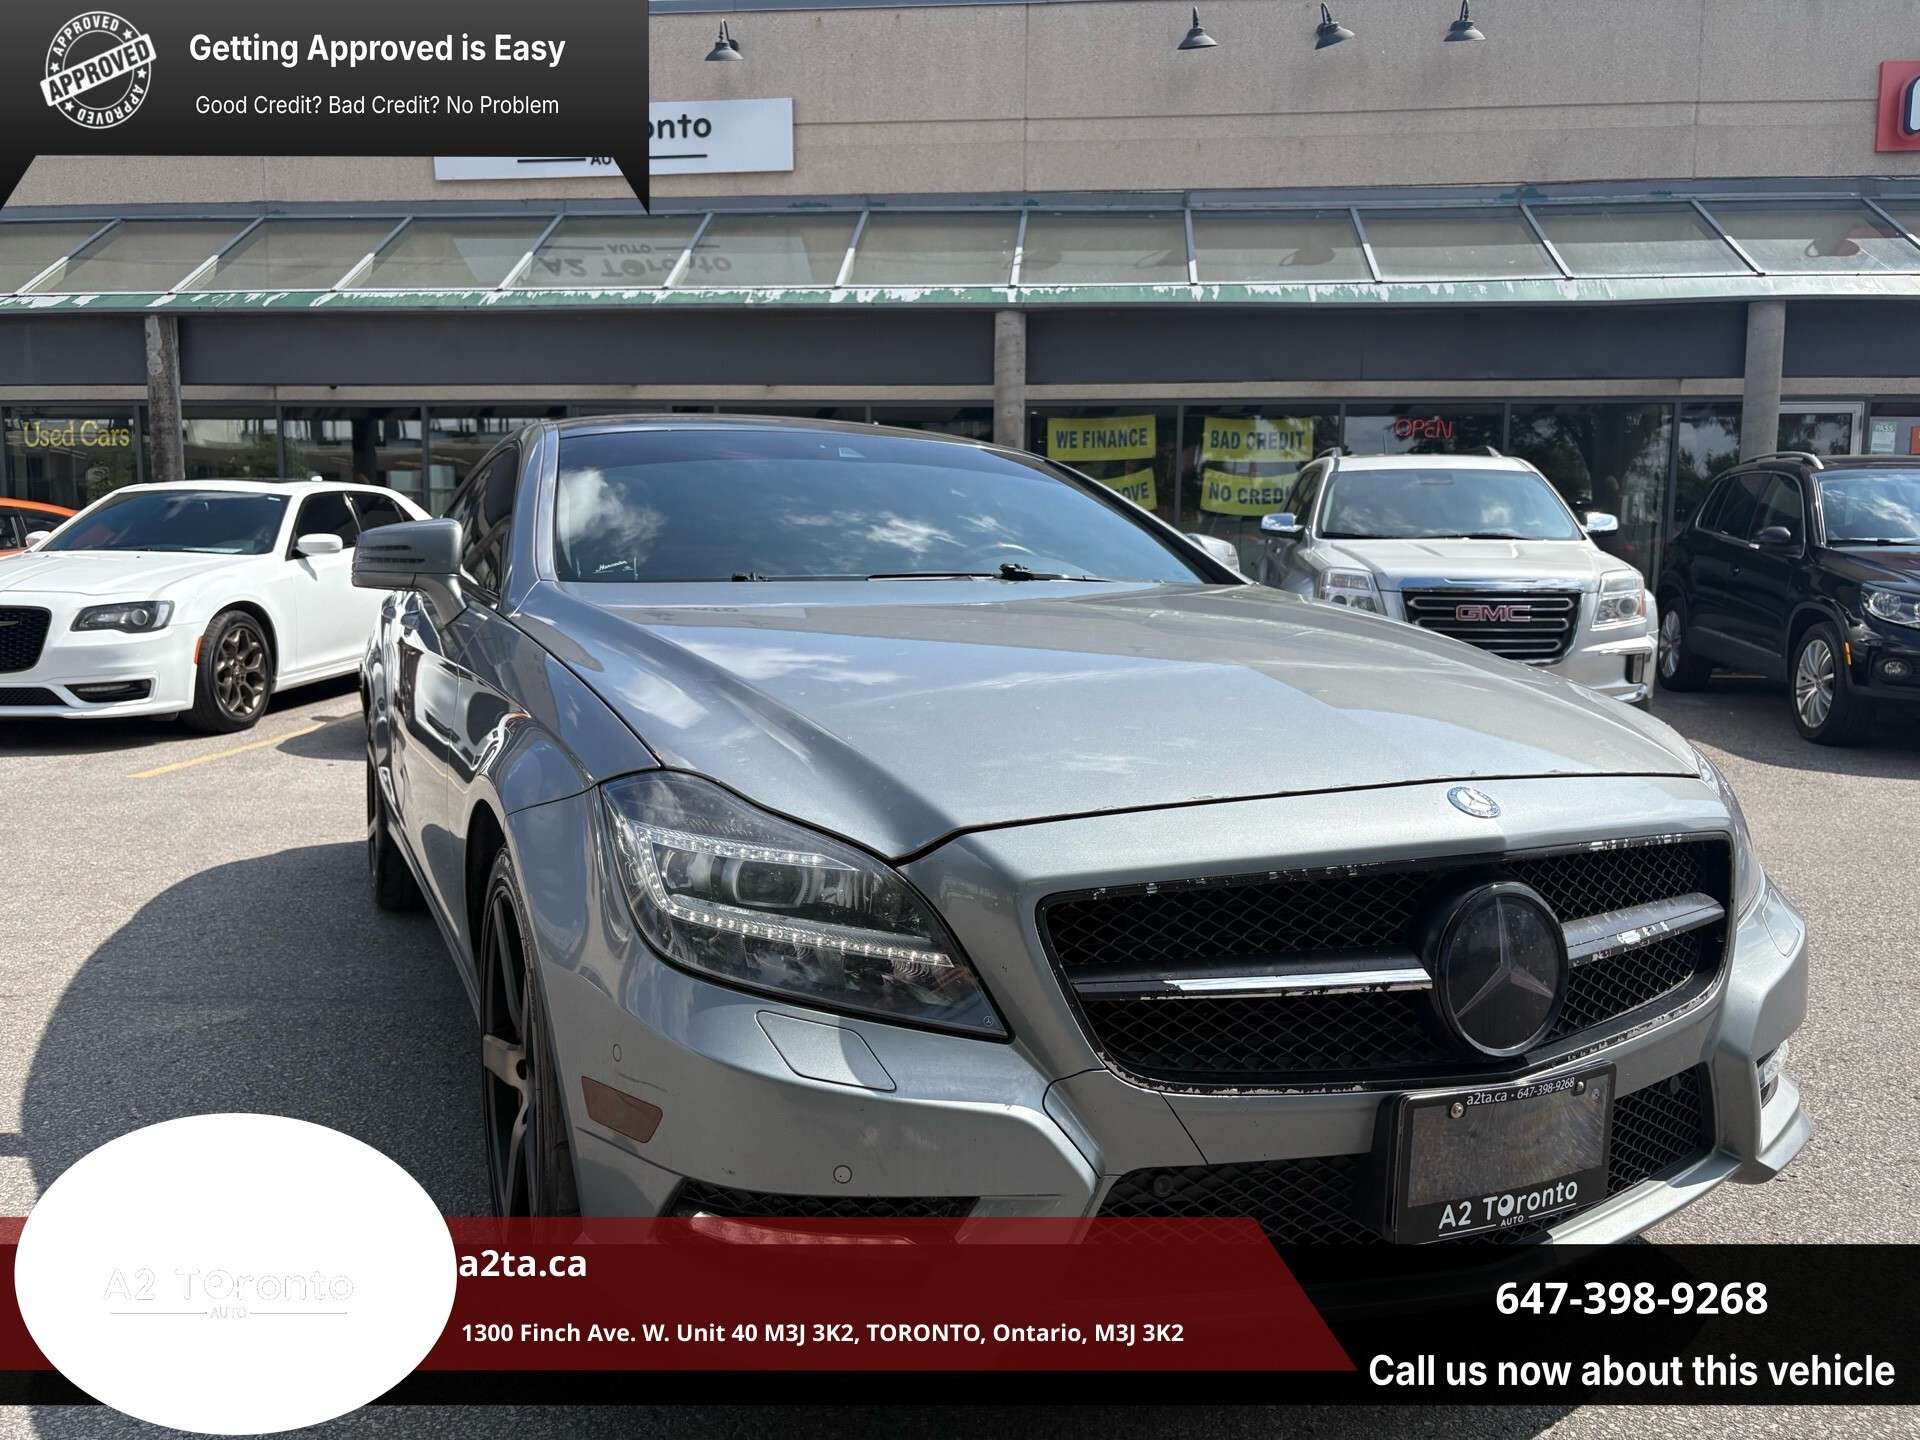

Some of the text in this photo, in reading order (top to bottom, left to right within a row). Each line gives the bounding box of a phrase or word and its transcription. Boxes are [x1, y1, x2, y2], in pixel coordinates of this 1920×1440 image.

[23, 419, 130, 447] Used Cars
[1056, 427, 1148, 449] WE FINANCE
[1395, 418, 1453, 439] OPEN
[1210, 429, 1305, 450] BAD CREDIT
[1209, 482, 1232, 502] NO
[1456, 604, 1532, 622] GMC
[1466, 1077, 1575, 1106] a2ta.ca 647-398-9268
[1438, 1200, 1473, 1230] A2
[1500, 1214, 1524, 1227] AUTO
